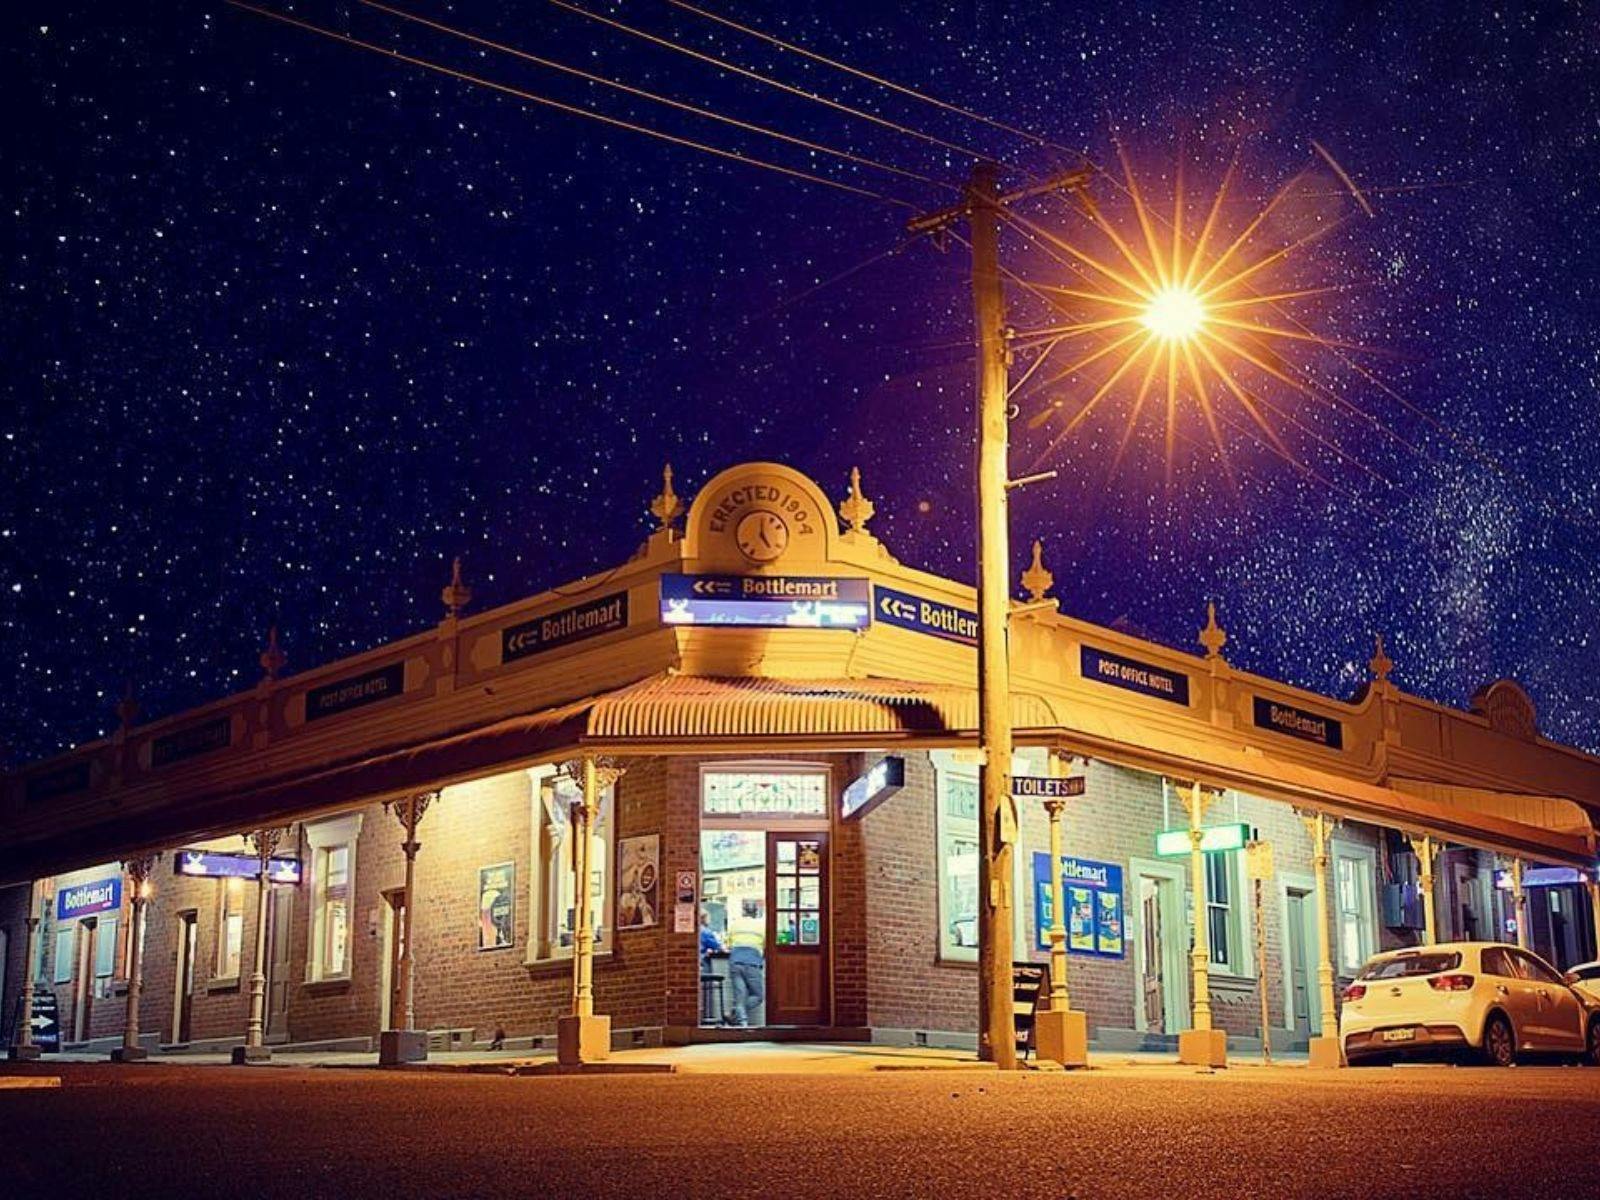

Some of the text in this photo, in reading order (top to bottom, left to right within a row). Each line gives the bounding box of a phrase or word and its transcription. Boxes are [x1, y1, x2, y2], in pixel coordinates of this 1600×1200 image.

[710, 485, 814, 535] ERECTED 1904
[743, 579, 838, 597] Bottlemart
[541, 600, 621, 641] Bottlemart
[1098, 659, 1174, 693] POST OFFICE HOTEL
[1270, 705, 1326, 737] Bottlemart
[1015, 778, 1069, 795] TOILETS
[1060, 860, 1107, 881] ttlemart
[65, 883, 113, 911] Bottlemart
